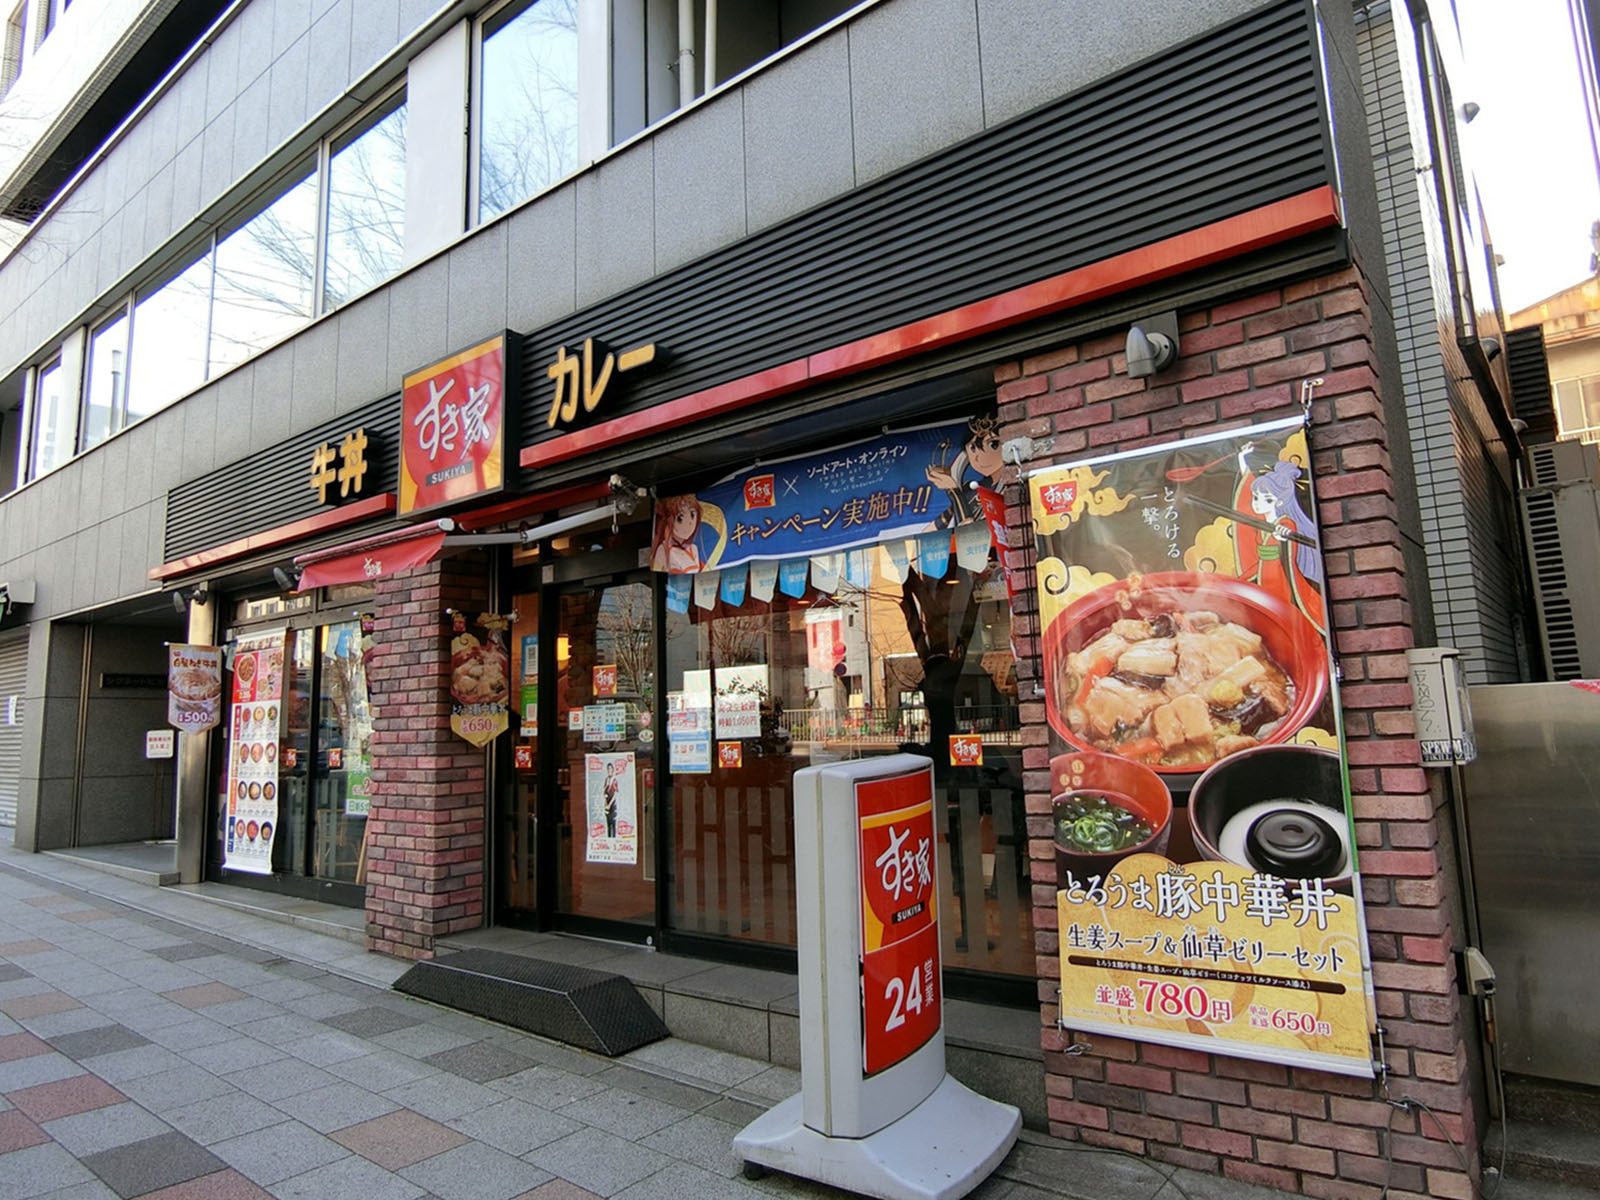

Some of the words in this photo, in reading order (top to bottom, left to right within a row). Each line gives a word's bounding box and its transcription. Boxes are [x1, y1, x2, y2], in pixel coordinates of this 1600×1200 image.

[547, 336, 656, 430] カレー
[414, 377, 491, 461] すき家
[310, 427, 368, 505] 牛丼
[431, 466, 467, 485] SUKIYA
[807, 446, 908, 479] ソードアート・オンライン
[730, 486, 932, 547] キャンペーン実施中!!
[1044, 485, 1074, 505] すき家
[1140, 494, 1161, 531] 一撃。
[1163, 486, 1181, 559] とろける
[952, 737, 979, 757] すき家
[875, 826, 932, 900] すき家
[896, 904, 923, 923] SUKIYA
[1065, 869, 1340, 931] とろうま豚中華丼
[1067, 923, 1346, 974] 生姜スープ&仙草ゼリーセット
[885, 966, 923, 1033] 24
[1096, 979, 1233, 1022] 並盛780円
[1271, 1008, 1331, 1035] 650円
